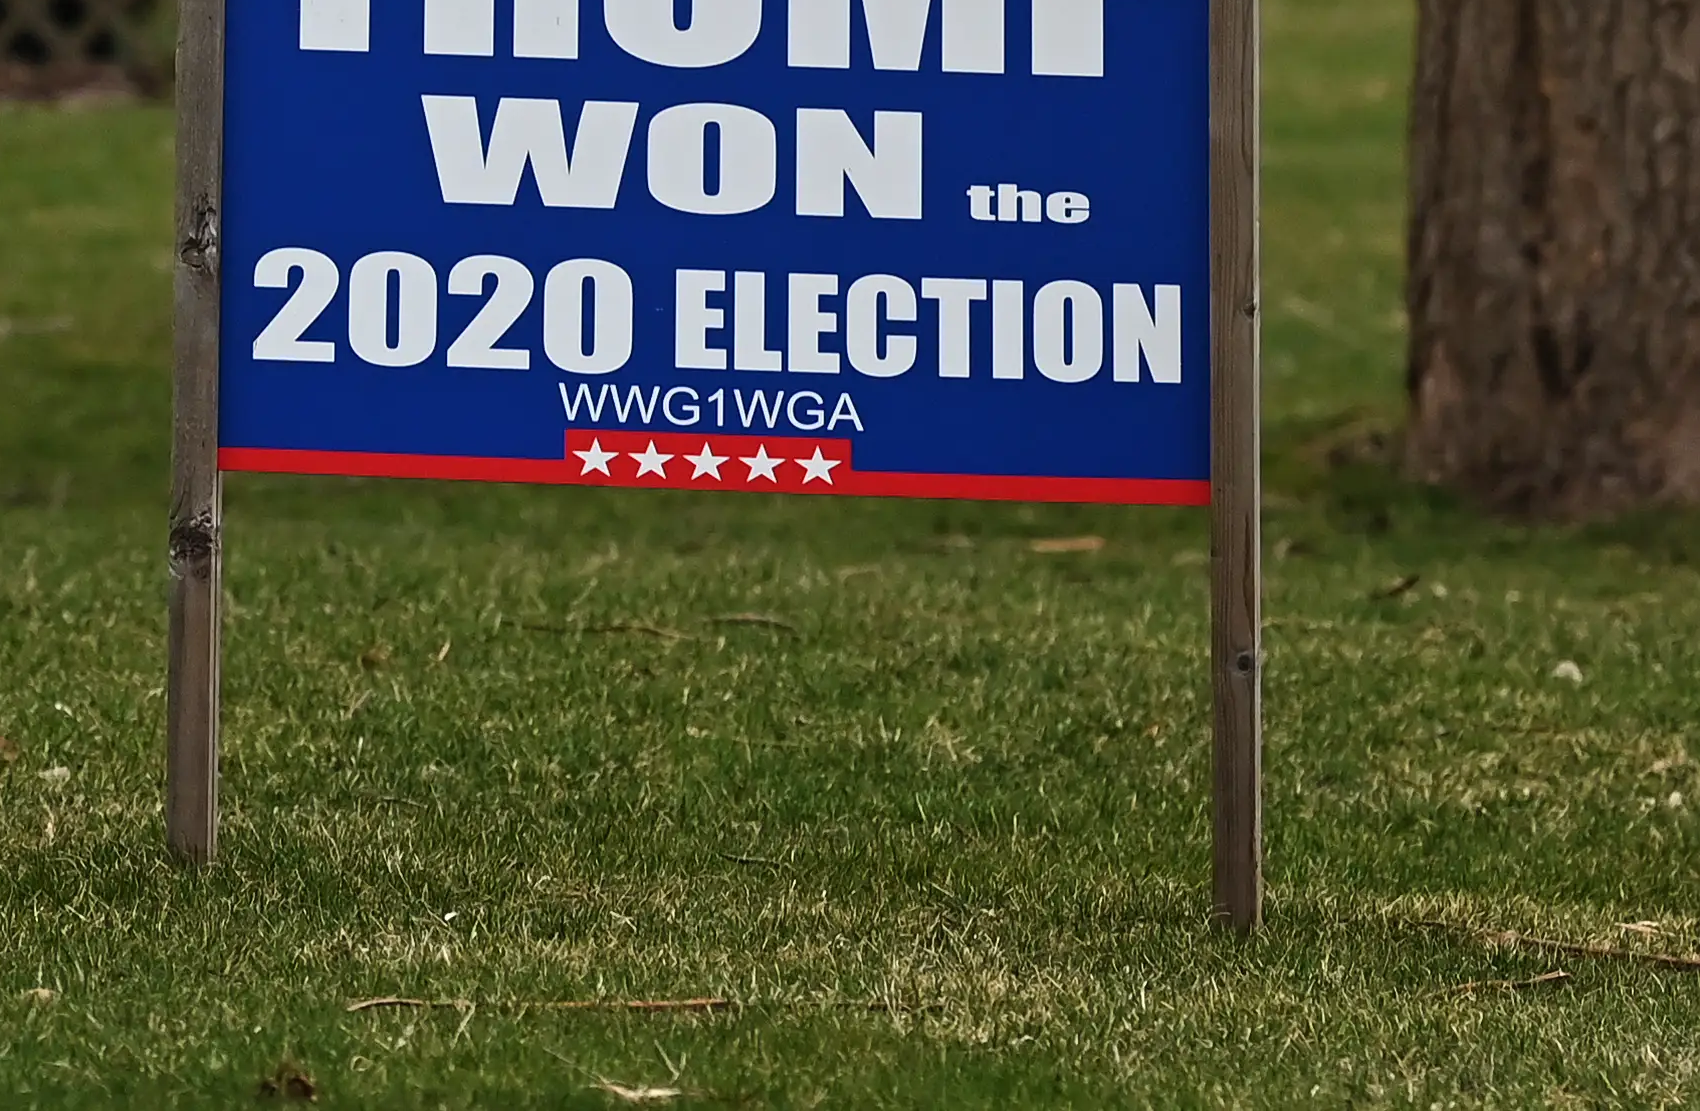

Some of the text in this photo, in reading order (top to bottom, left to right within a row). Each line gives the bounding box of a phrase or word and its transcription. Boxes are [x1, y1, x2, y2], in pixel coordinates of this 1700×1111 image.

[420, 94, 1090, 224] WON the
[252, 247, 1182, 384] 2020 ELECTION
[558, 382, 864, 432] WWG1WGA
